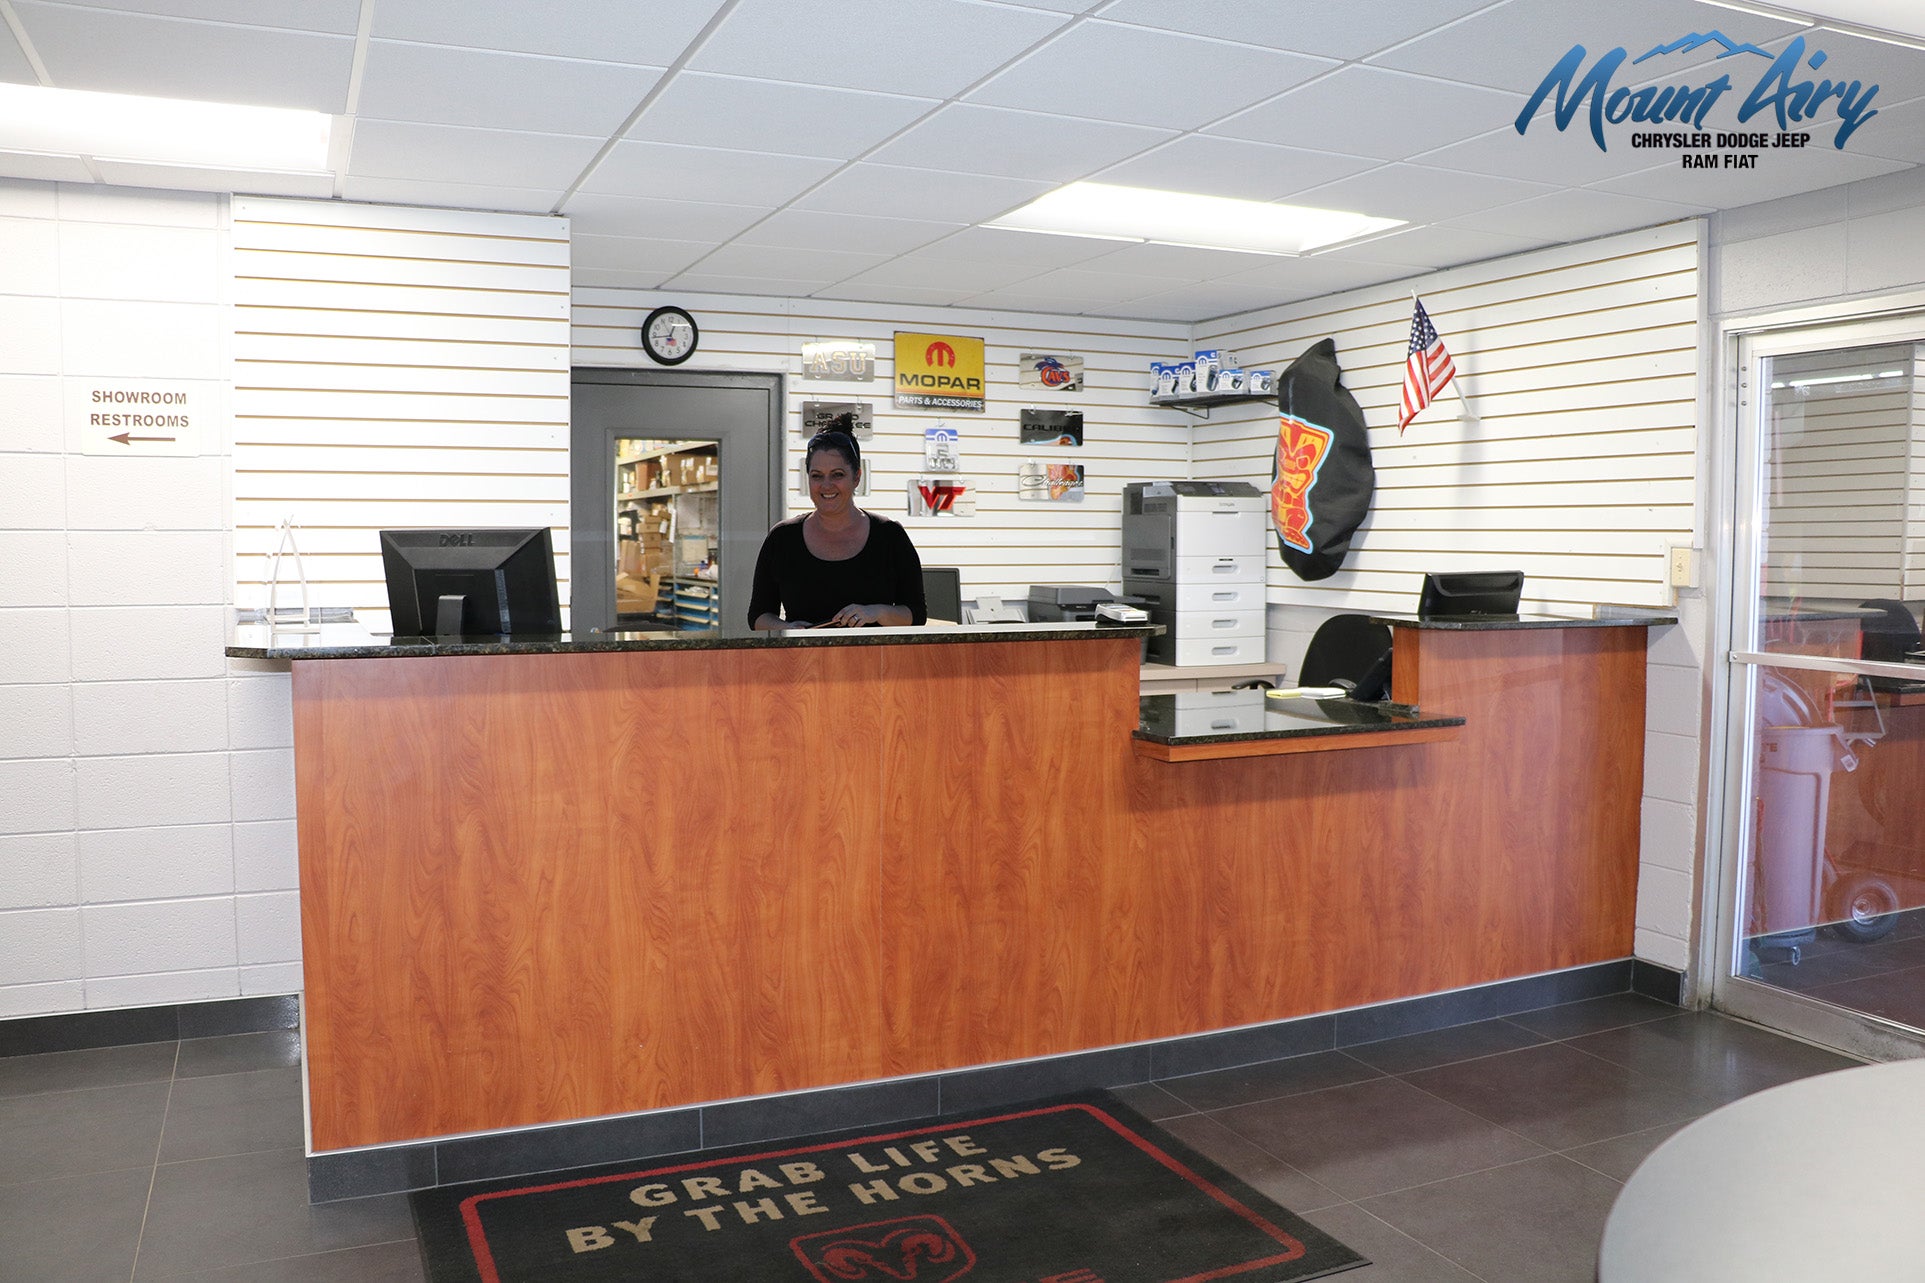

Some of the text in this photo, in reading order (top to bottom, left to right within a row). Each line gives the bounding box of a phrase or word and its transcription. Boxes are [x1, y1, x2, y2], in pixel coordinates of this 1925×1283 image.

[809, 351, 867, 375] ASU
[899, 373, 981, 391] MOPAR
[1041, 365, 1071, 387] CAVS
[91, 390, 187, 405] SHOWROOM
[898, 395, 983, 409] PARTS & ACCESSORIES
[90, 413, 189, 427] RESTROOMS
[804, 420, 872, 430] CHEEE
[816, 412, 860, 421] GRD
[917, 486, 967, 511] VT
[439, 532, 476, 548] DELL
[629, 1135, 988, 1208] GRAB LIFE
[565, 1148, 1082, 1254] BY THE HORNS
